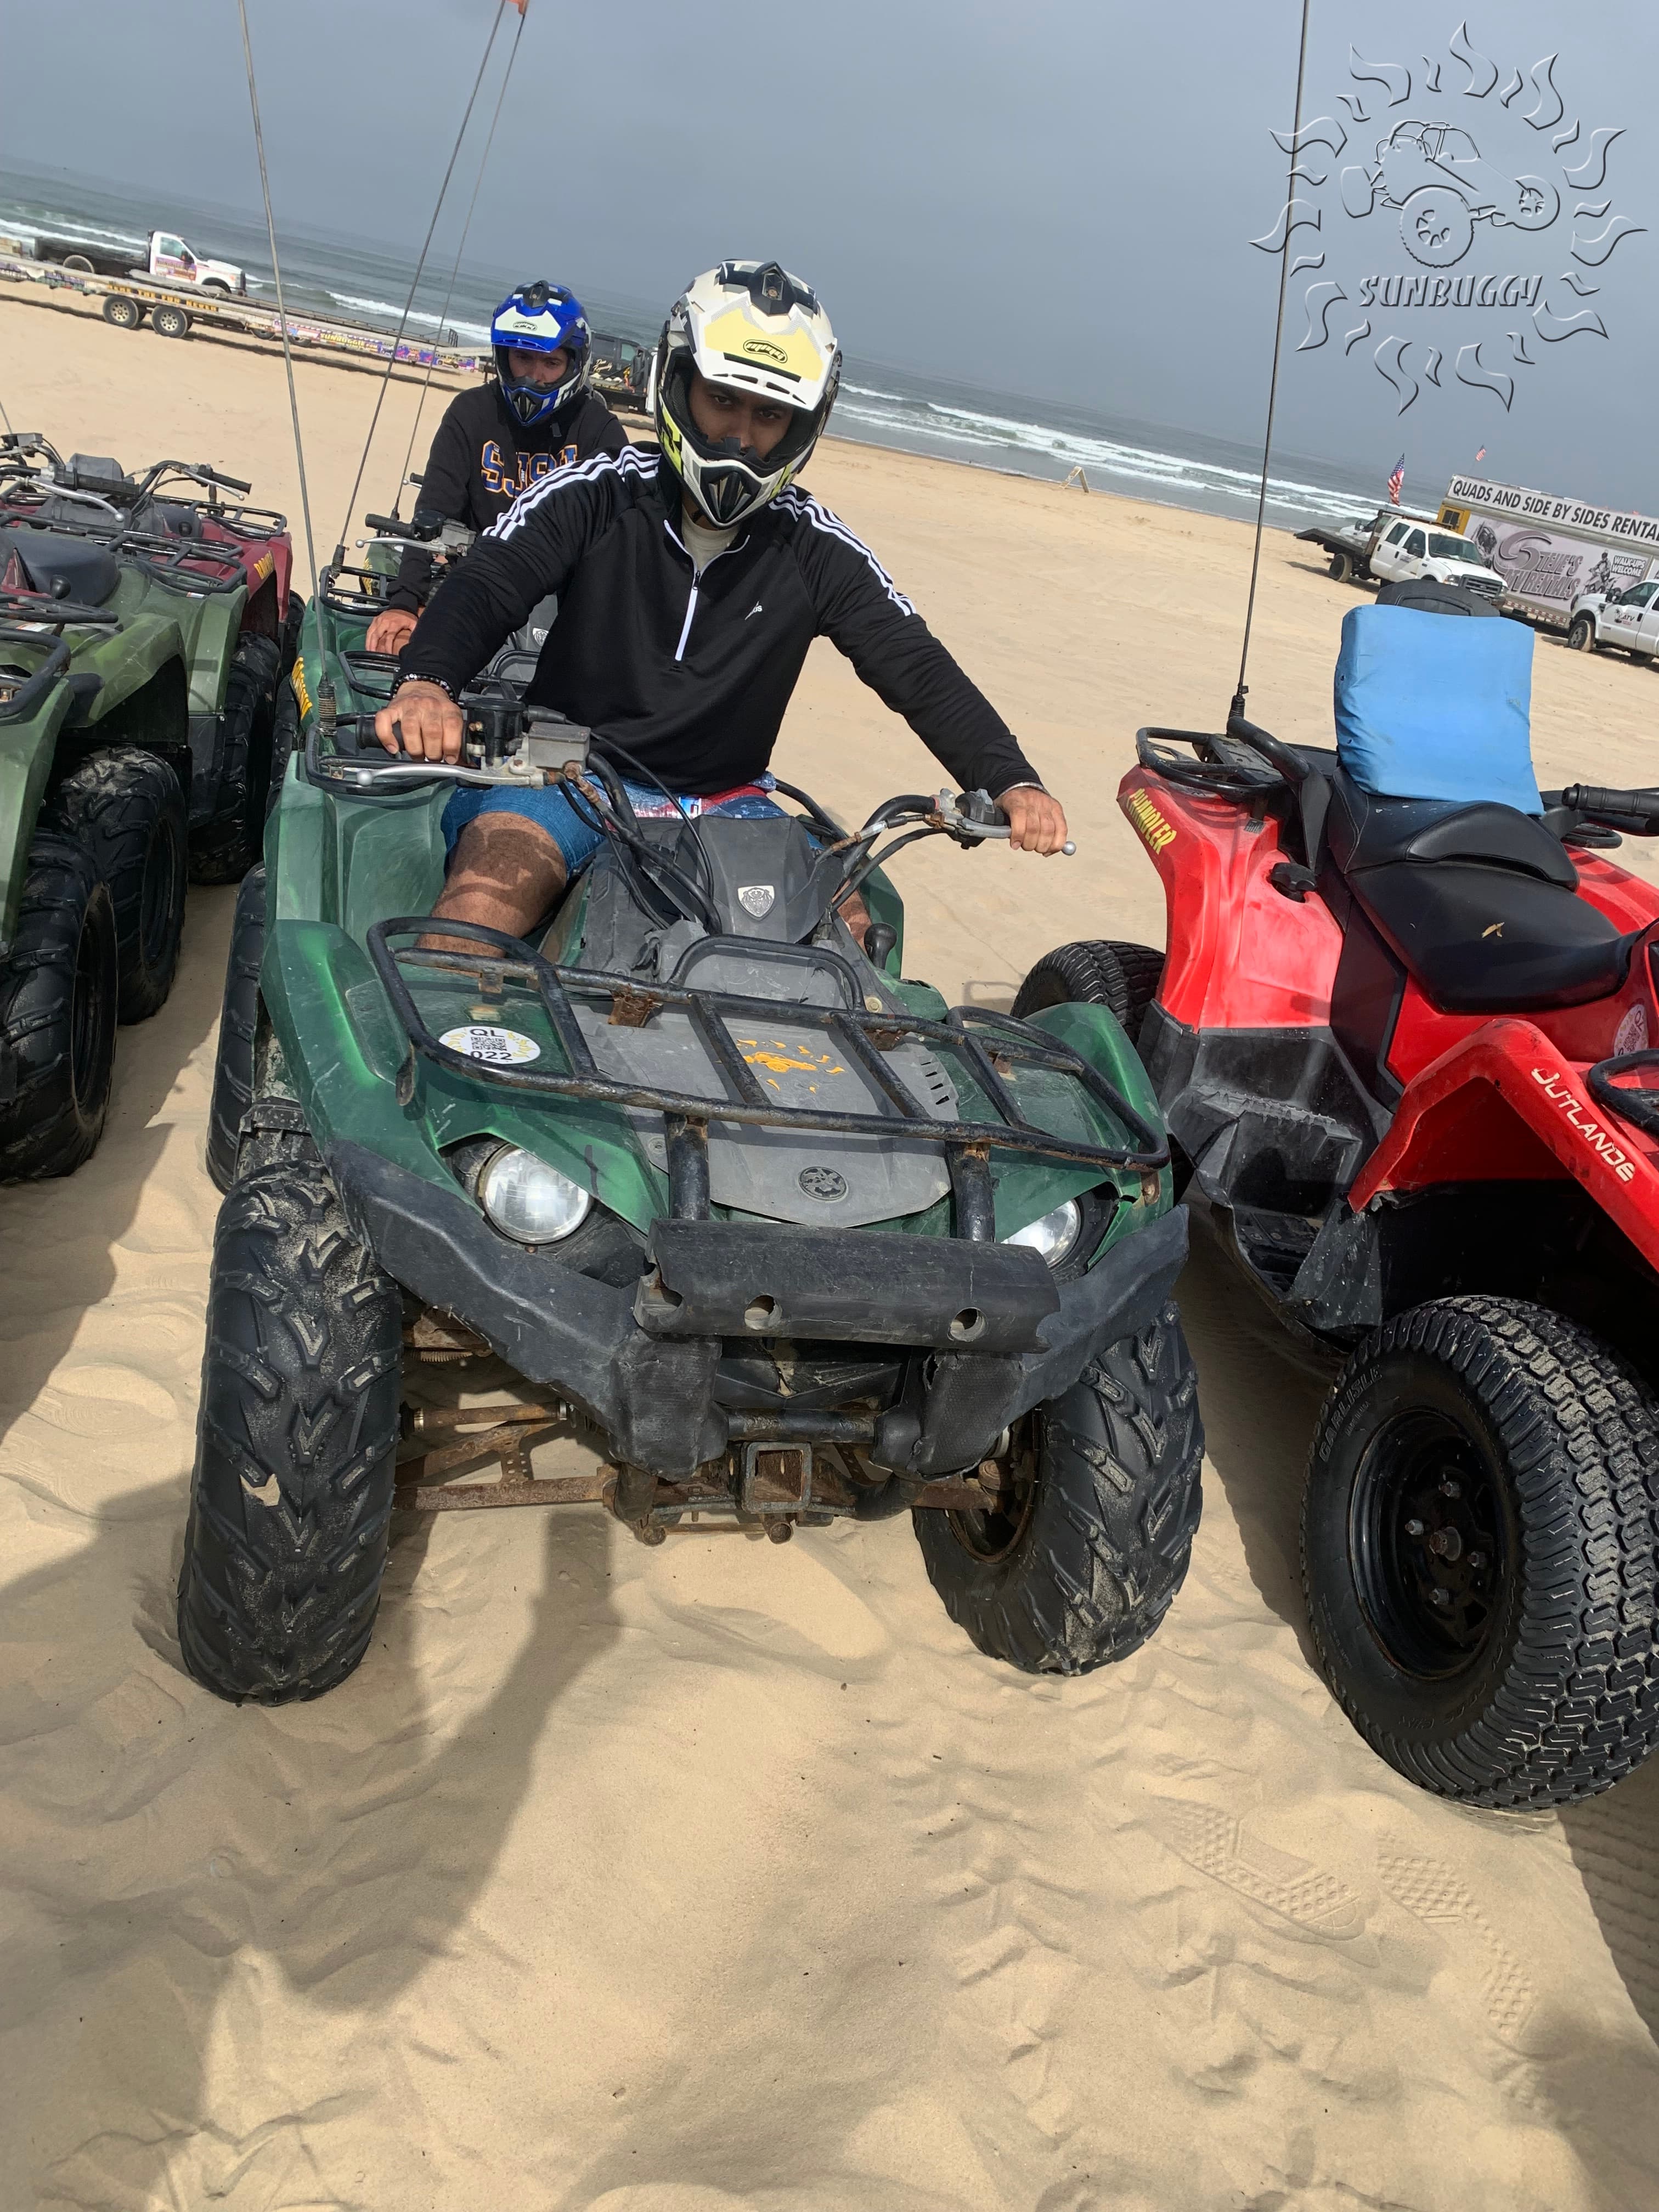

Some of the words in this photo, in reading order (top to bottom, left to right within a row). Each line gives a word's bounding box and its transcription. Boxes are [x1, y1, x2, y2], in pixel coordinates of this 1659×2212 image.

[1453, 480, 1493, 501] QUADS
[1492, 490, 1521, 508] AND
[1522, 496, 1552, 516] SIDE
[1552, 503, 1572, 520] BY
[1571, 507, 1611, 529] SIDES
[1613, 555, 1646, 569] WALK-UPS
[1611, 564, 1643, 577] WELCOME
[1520, 571, 1581, 600] RENTALS
[470, 1028, 505, 1037] QL
[471, 1051, 513, 1061] 022
[1319, 1364, 1383, 1462] CARLISLE
